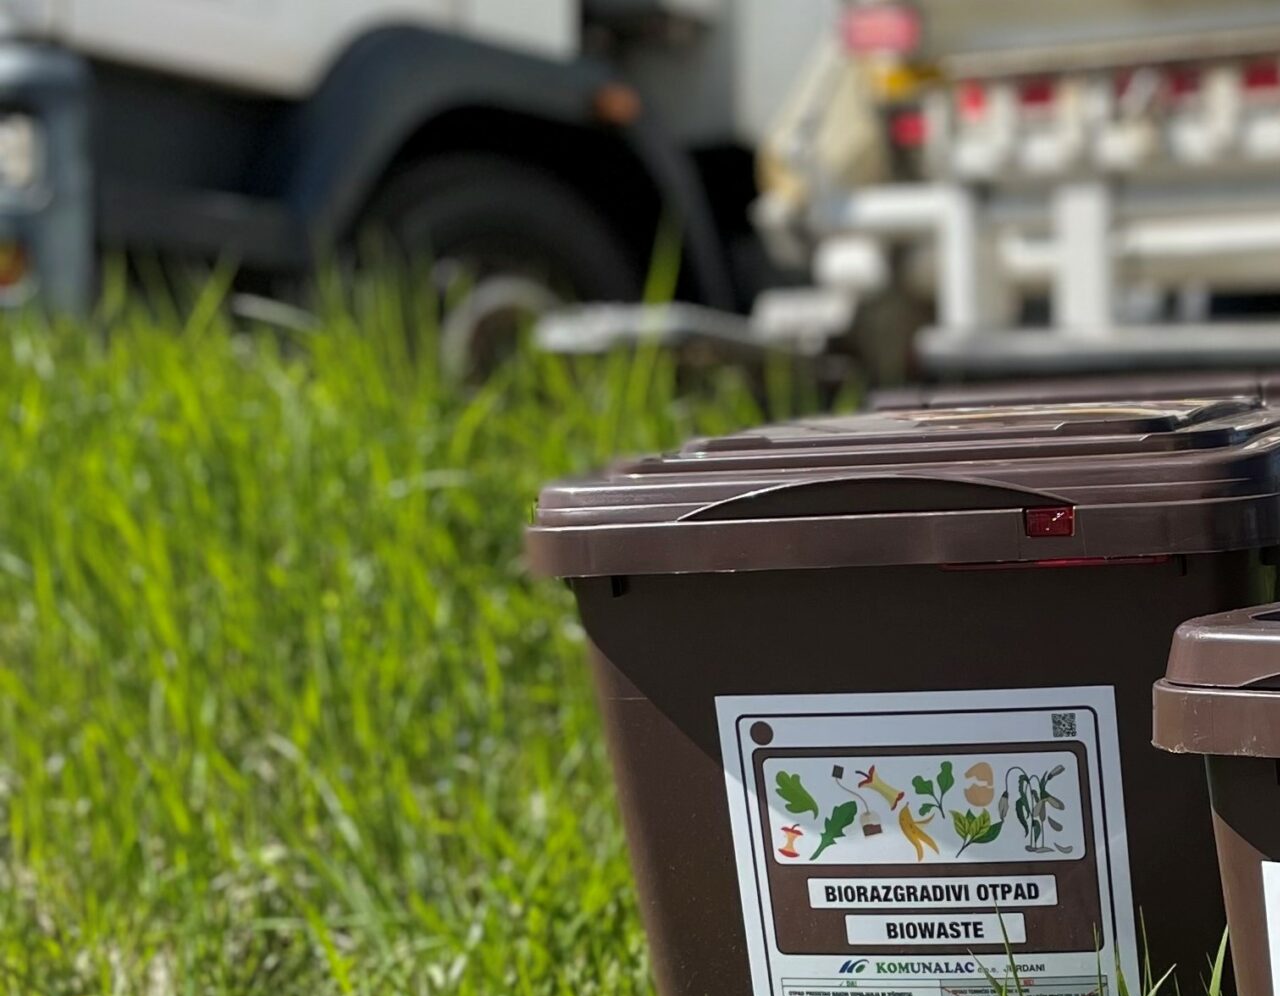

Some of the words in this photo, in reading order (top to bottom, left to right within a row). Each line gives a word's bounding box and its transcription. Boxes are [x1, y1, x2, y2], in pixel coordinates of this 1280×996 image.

[824, 884, 970, 902] BIORAZGRADIVI
[976, 882, 1039, 901] OTPAD
[886, 921, 985, 939] BIOWASTE
[876, 961, 975, 974] KOMUNALAC
